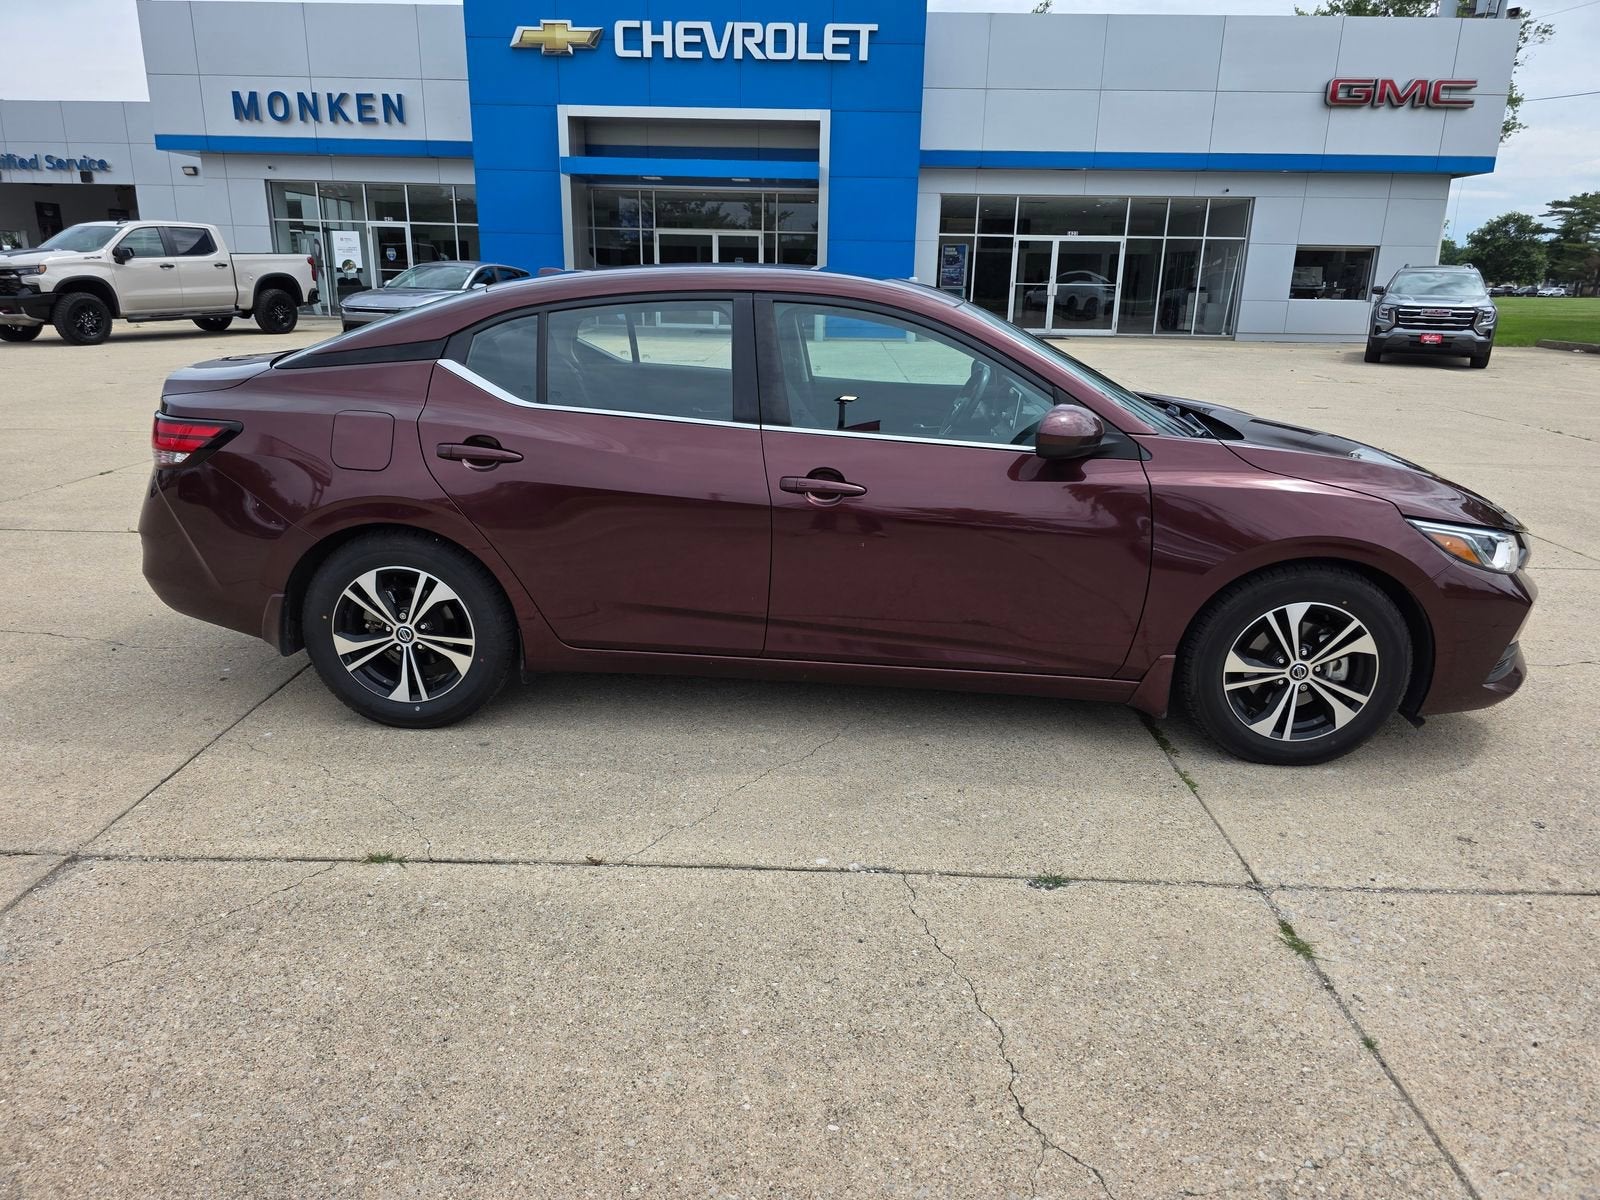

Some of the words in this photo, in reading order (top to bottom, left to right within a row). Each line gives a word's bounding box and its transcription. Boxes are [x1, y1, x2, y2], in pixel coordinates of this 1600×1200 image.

[614, 20, 879, 61] CHEVROLET
[231, 90, 407, 125] MONKEN
[1326, 77, 1478, 109] GMC
[44, 154, 109, 171] Service
